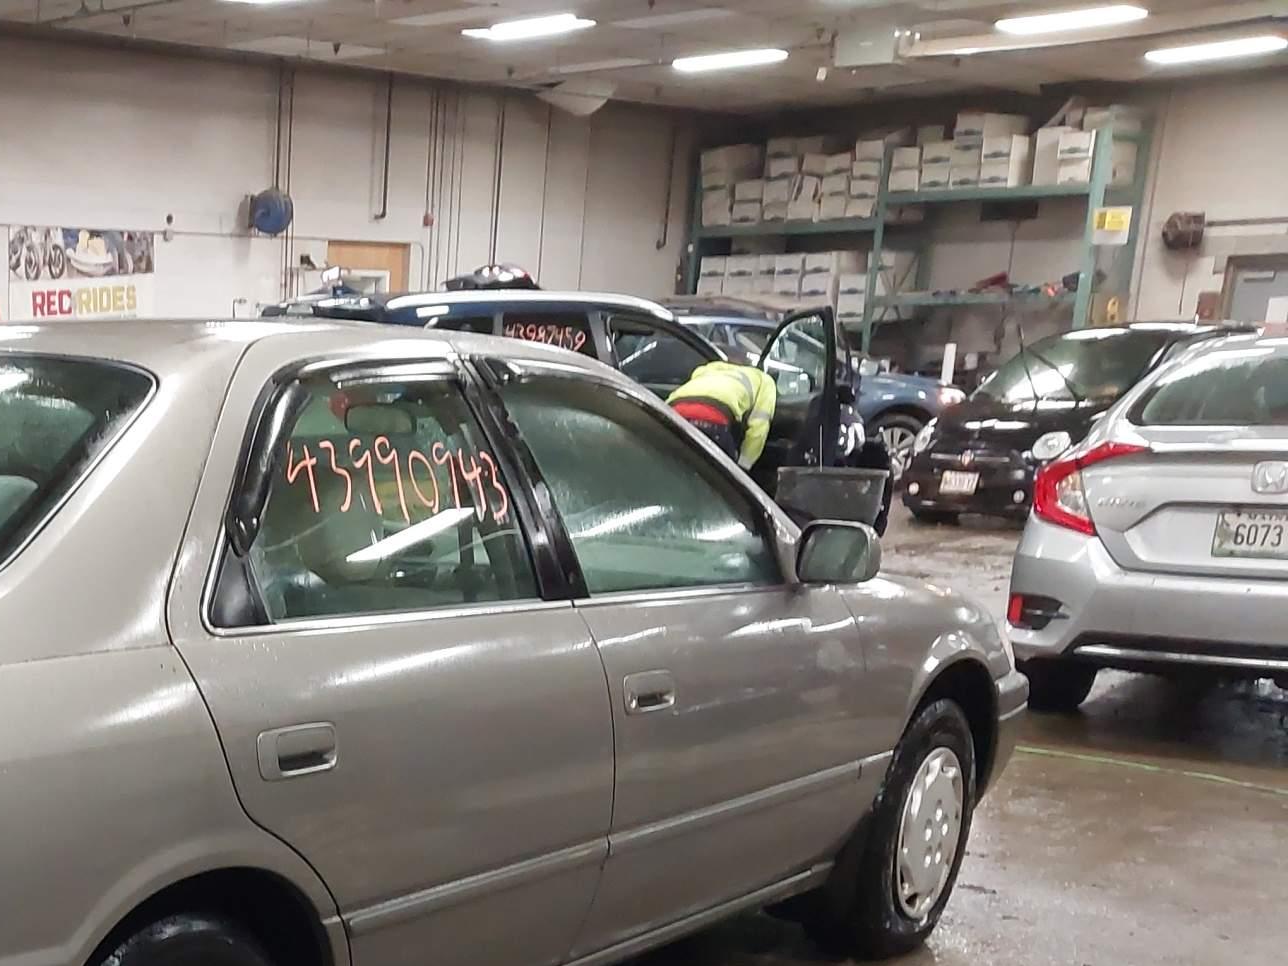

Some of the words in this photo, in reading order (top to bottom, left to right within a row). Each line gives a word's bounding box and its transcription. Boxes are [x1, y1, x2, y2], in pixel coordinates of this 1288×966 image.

[32, 289, 72, 317] REC
[77, 285, 137, 314] RIDES
[286, 435, 509, 525] 43990943
